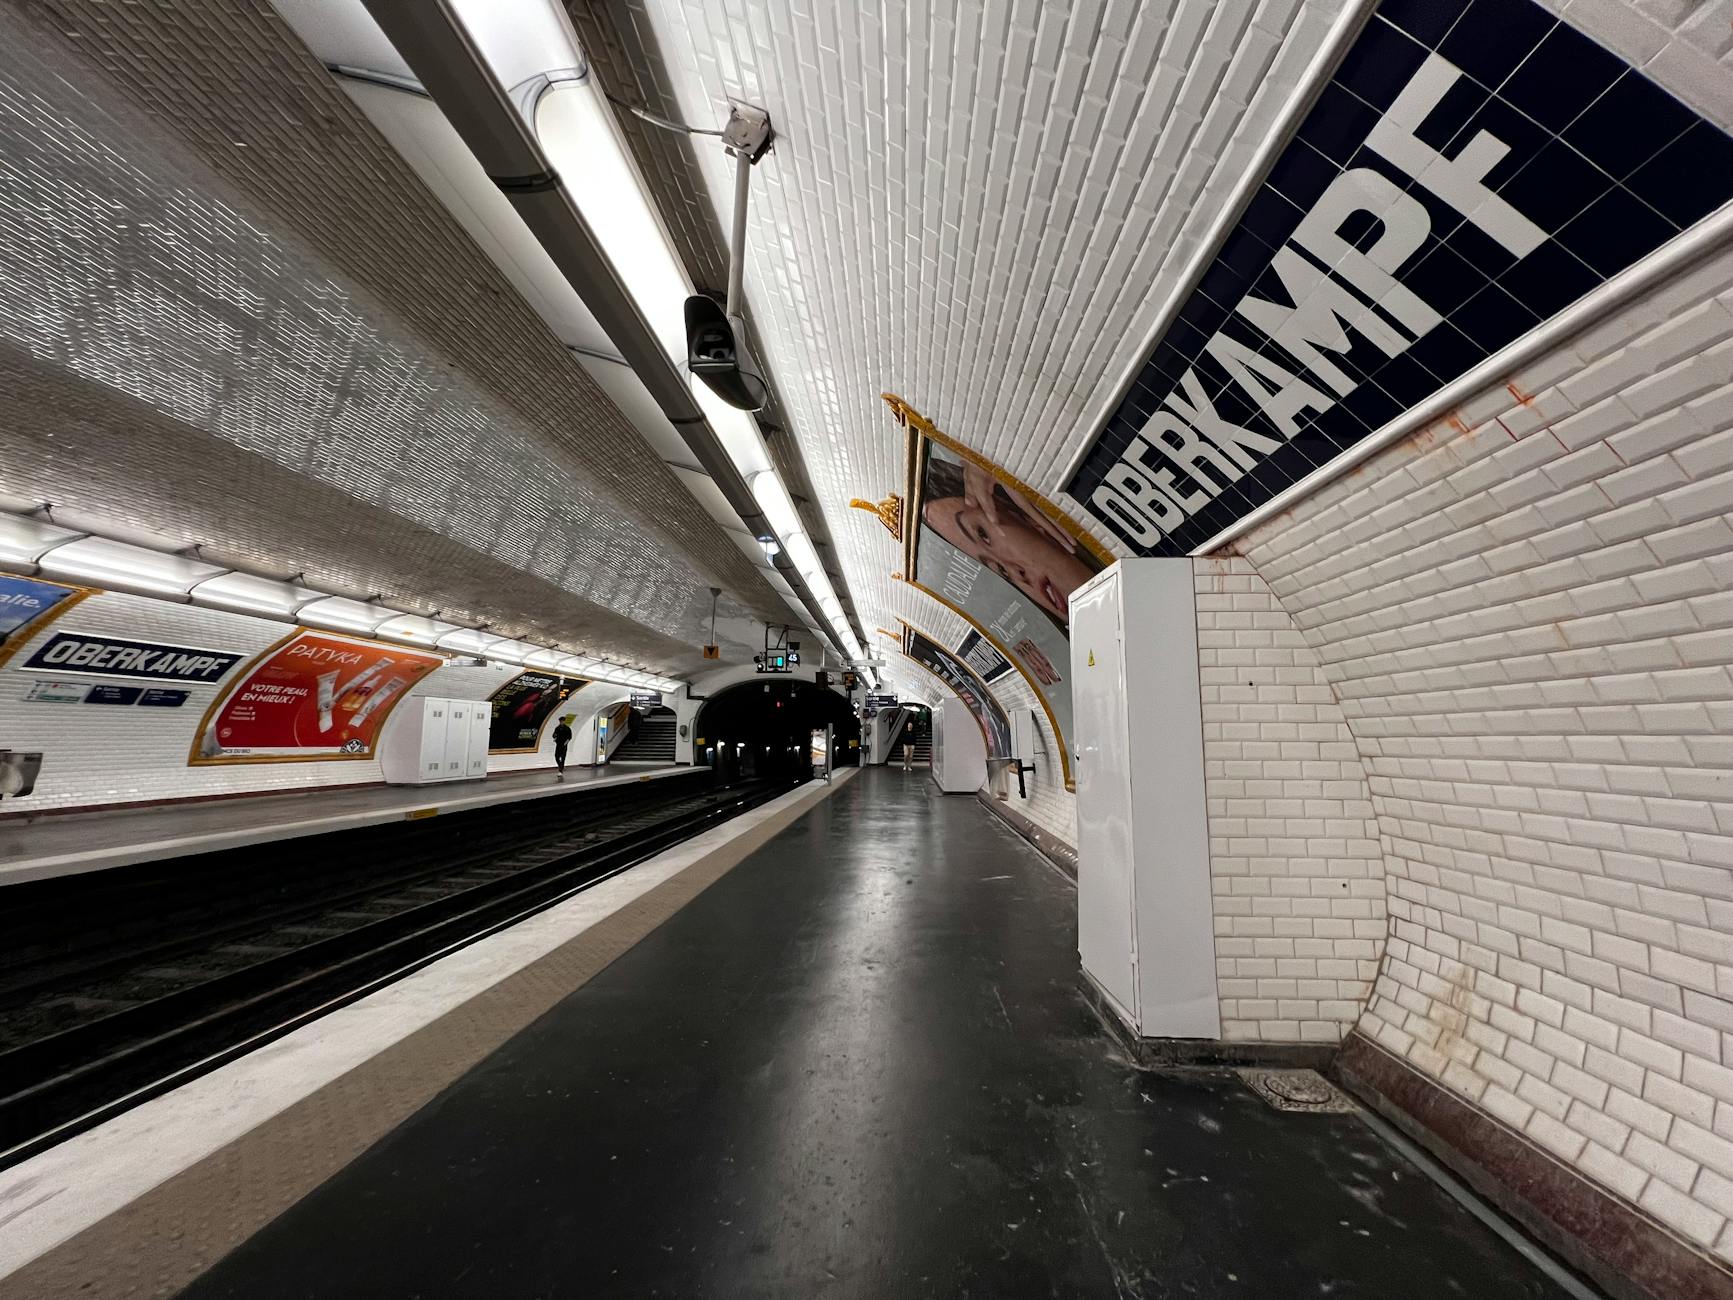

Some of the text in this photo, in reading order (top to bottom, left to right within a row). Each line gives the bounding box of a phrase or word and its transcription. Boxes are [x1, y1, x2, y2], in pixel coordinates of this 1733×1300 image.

[1092, 51, 1551, 549] OBERKAMPF
[42, 640, 230, 677] OBERKAMPF
[286, 644, 363, 665] PATYKA
[240, 692, 258, 701] EN
[256, 694, 290, 704] MIEUX
[250, 683, 309, 697] VOTRE PEAU,
